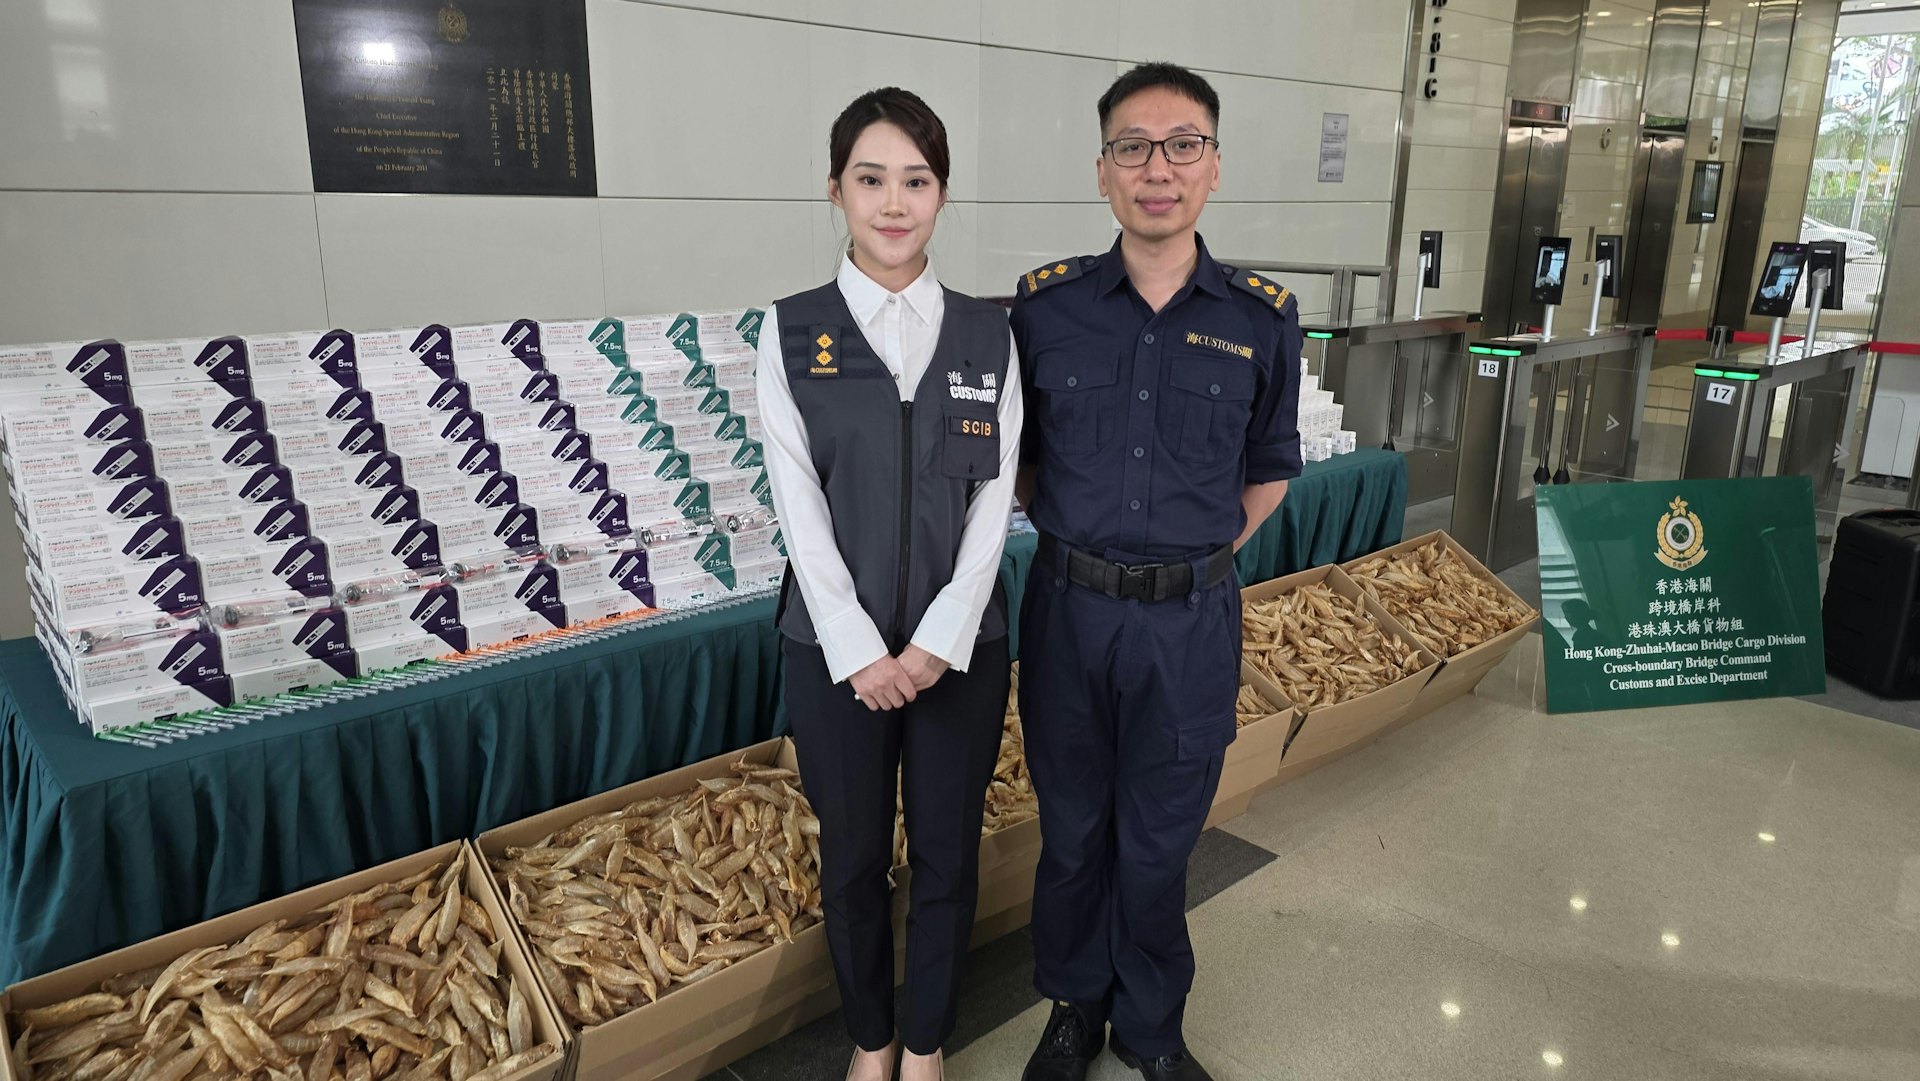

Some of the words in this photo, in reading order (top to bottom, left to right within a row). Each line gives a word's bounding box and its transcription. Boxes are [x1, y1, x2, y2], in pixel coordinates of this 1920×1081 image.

[1198, 334, 1243, 356] CUSTOMS
[104, 372, 122, 381] 5mg
[227, 366, 244, 375] 5mg
[1482, 363, 1496, 374] 18
[949, 386, 997, 403] CUSTOMS
[1712, 386, 1731, 400] 17
[962, 420, 991, 436] SCIB
[307, 572, 324, 581] 5mg
[1655, 576, 1712, 595] 香港海關
[178, 593, 198, 602] 5mg
[1648, 597, 1720, 616] 跨境橋岸科
[1628, 617, 1744, 638] 港珠澳大橋貨物組
[327, 641, 344, 650] 5mg
[1564, 648, 1593, 661] Hong
[1594, 641, 1698, 659] Kong-Zhuhai-Macao
[1701, 638, 1733, 651] Bridge
[1734, 637, 1765, 650] Cargo
[1767, 634, 1806, 646] Division
[198, 666, 218, 676] 5mg
[1603, 659, 1683, 674] Cross-boundary
[1685, 656, 1718, 669] Bridge
[1720, 652, 1771, 666] Command
[1610, 679, 1653, 690] Customs
[1655, 676, 1674, 687] and
[1676, 673, 1708, 686] Excise
[1710, 670, 1768, 685] Department
